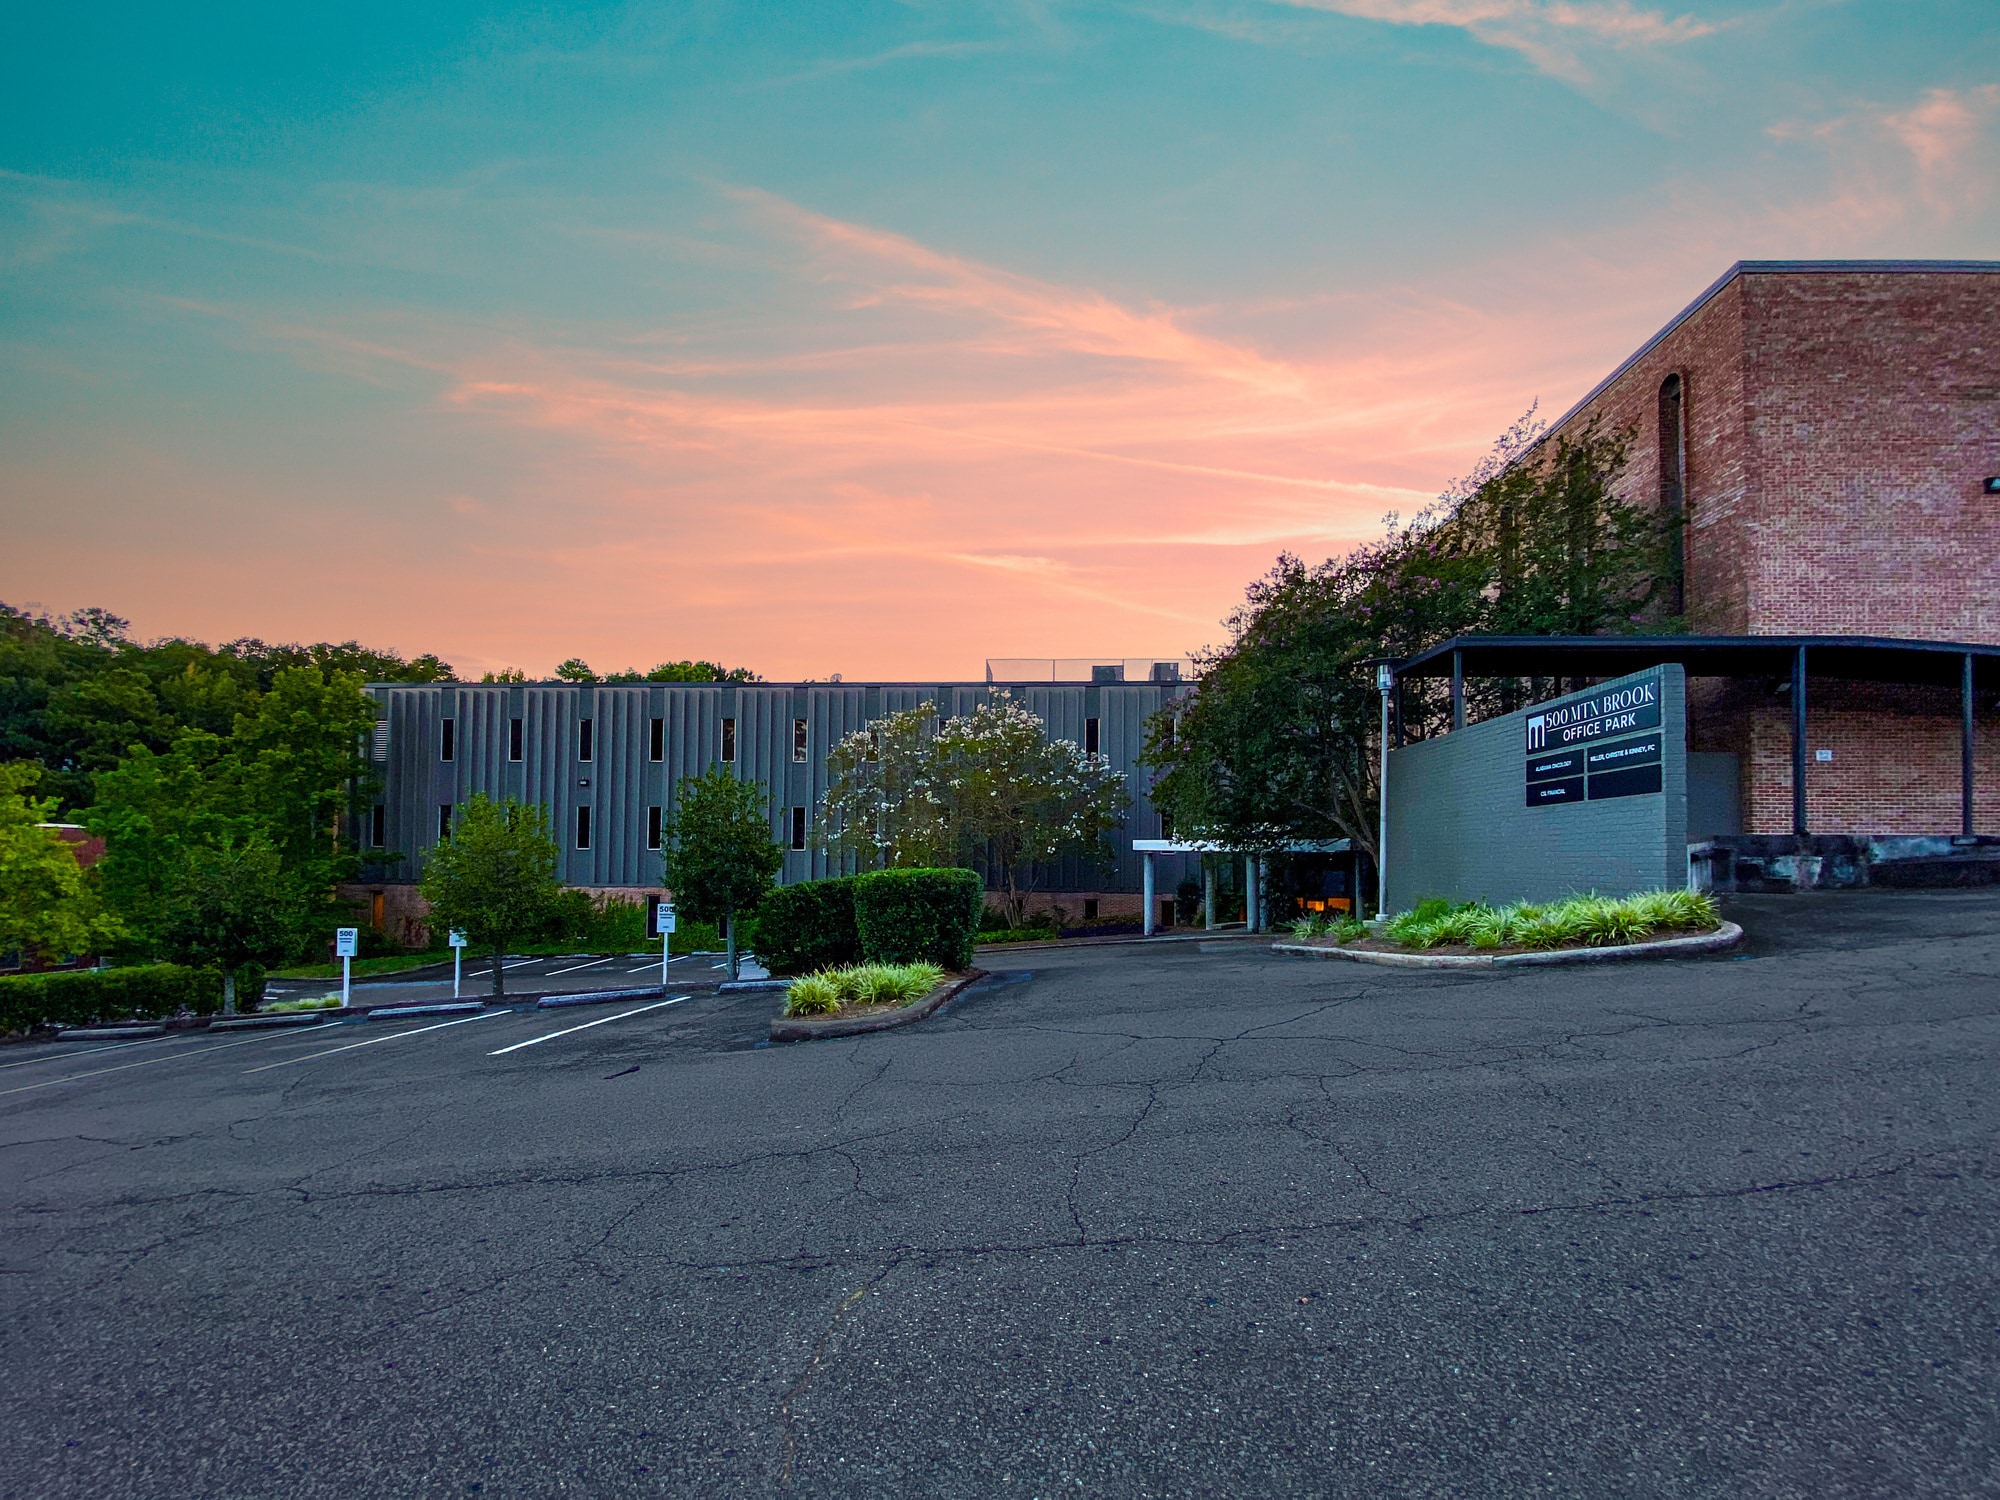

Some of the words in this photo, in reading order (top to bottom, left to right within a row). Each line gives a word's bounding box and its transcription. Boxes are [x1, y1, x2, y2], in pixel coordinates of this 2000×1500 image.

[1546, 708, 1568, 728] 500
[1571, 699, 1599, 721] MTN
[1603, 683, 1654, 713] BROOK
[1563, 721, 1601, 742] OFFICE
[1605, 712, 1636, 732] PARK
